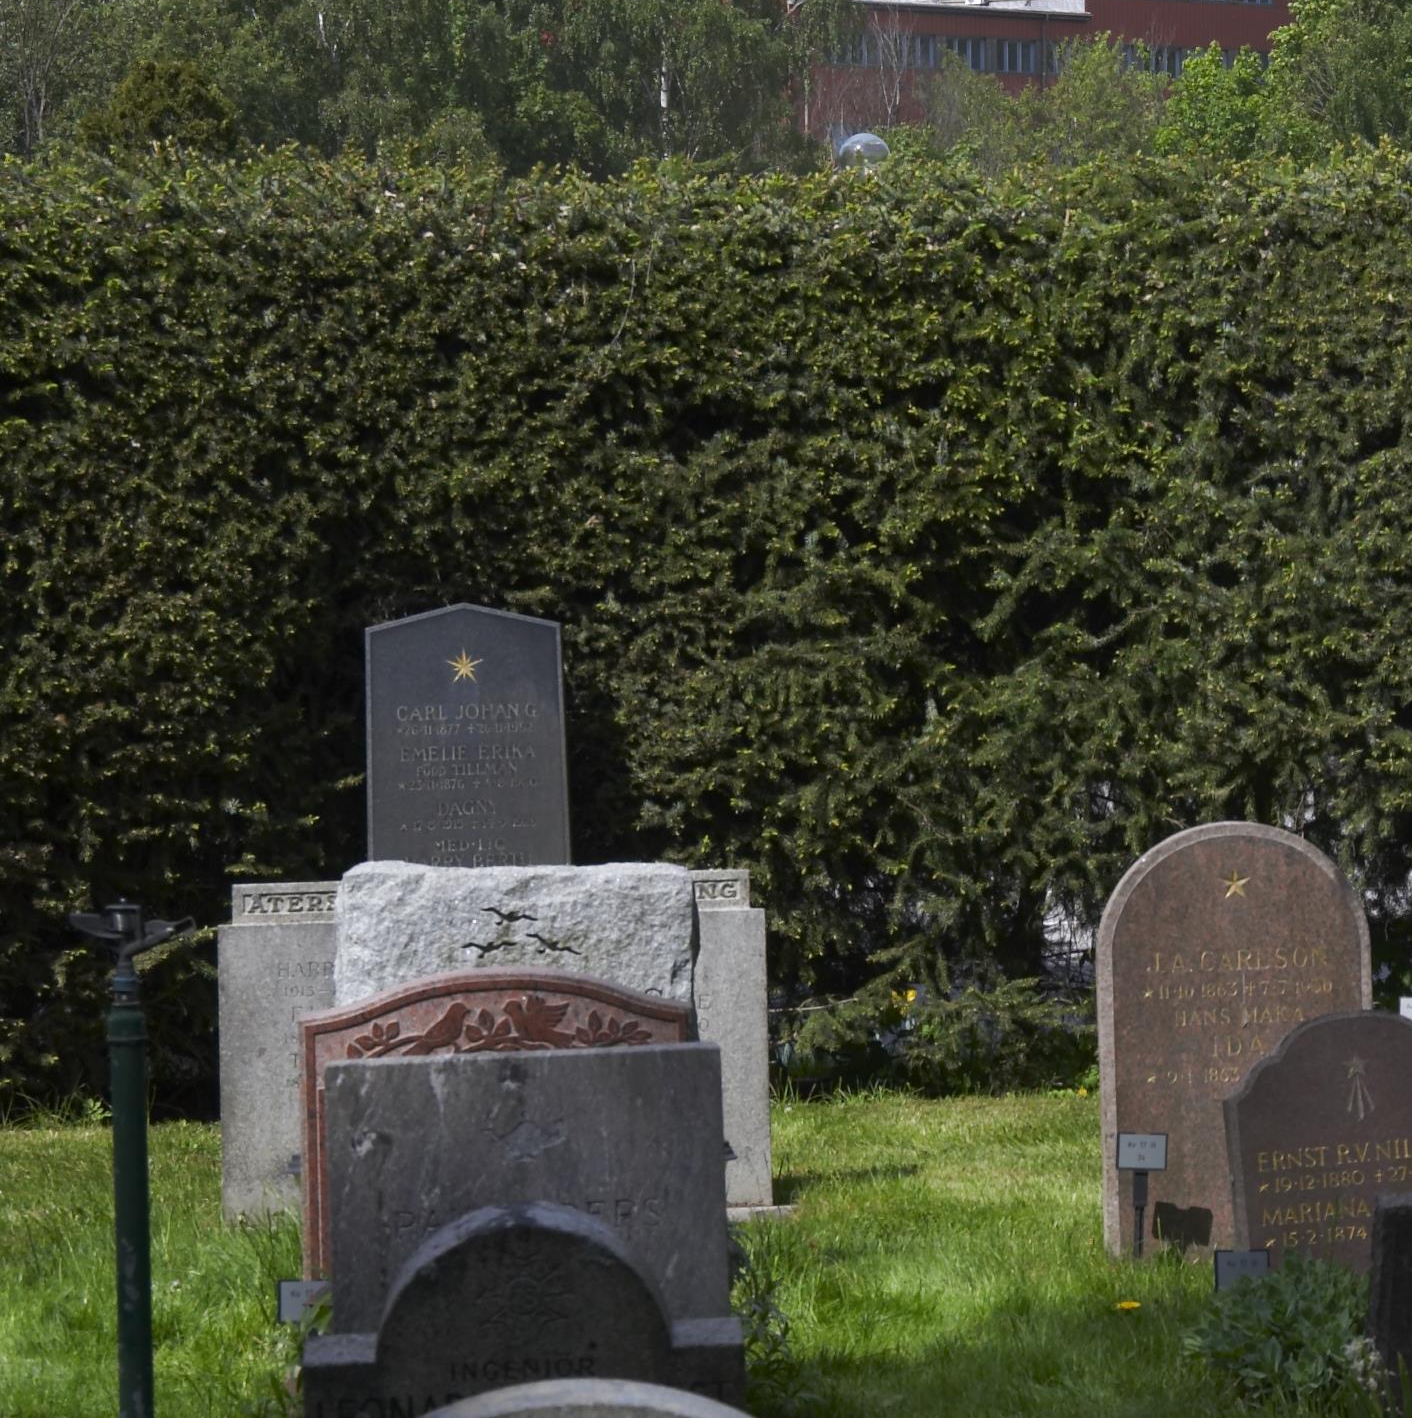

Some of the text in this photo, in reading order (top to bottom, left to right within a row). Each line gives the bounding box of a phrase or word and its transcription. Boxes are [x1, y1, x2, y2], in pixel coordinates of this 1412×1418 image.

[397, 704, 447, 721] CARL
[478, 743, 536, 760] ERIKA
[437, 798, 497, 816] DAGNY
[1200, 948, 1328, 971] CARLSON
[1175, 1007, 1231, 1027] HANS
[1257, 1147, 1328, 1173] ERNST
[1263, 1198, 1371, 1227] MARIANA
